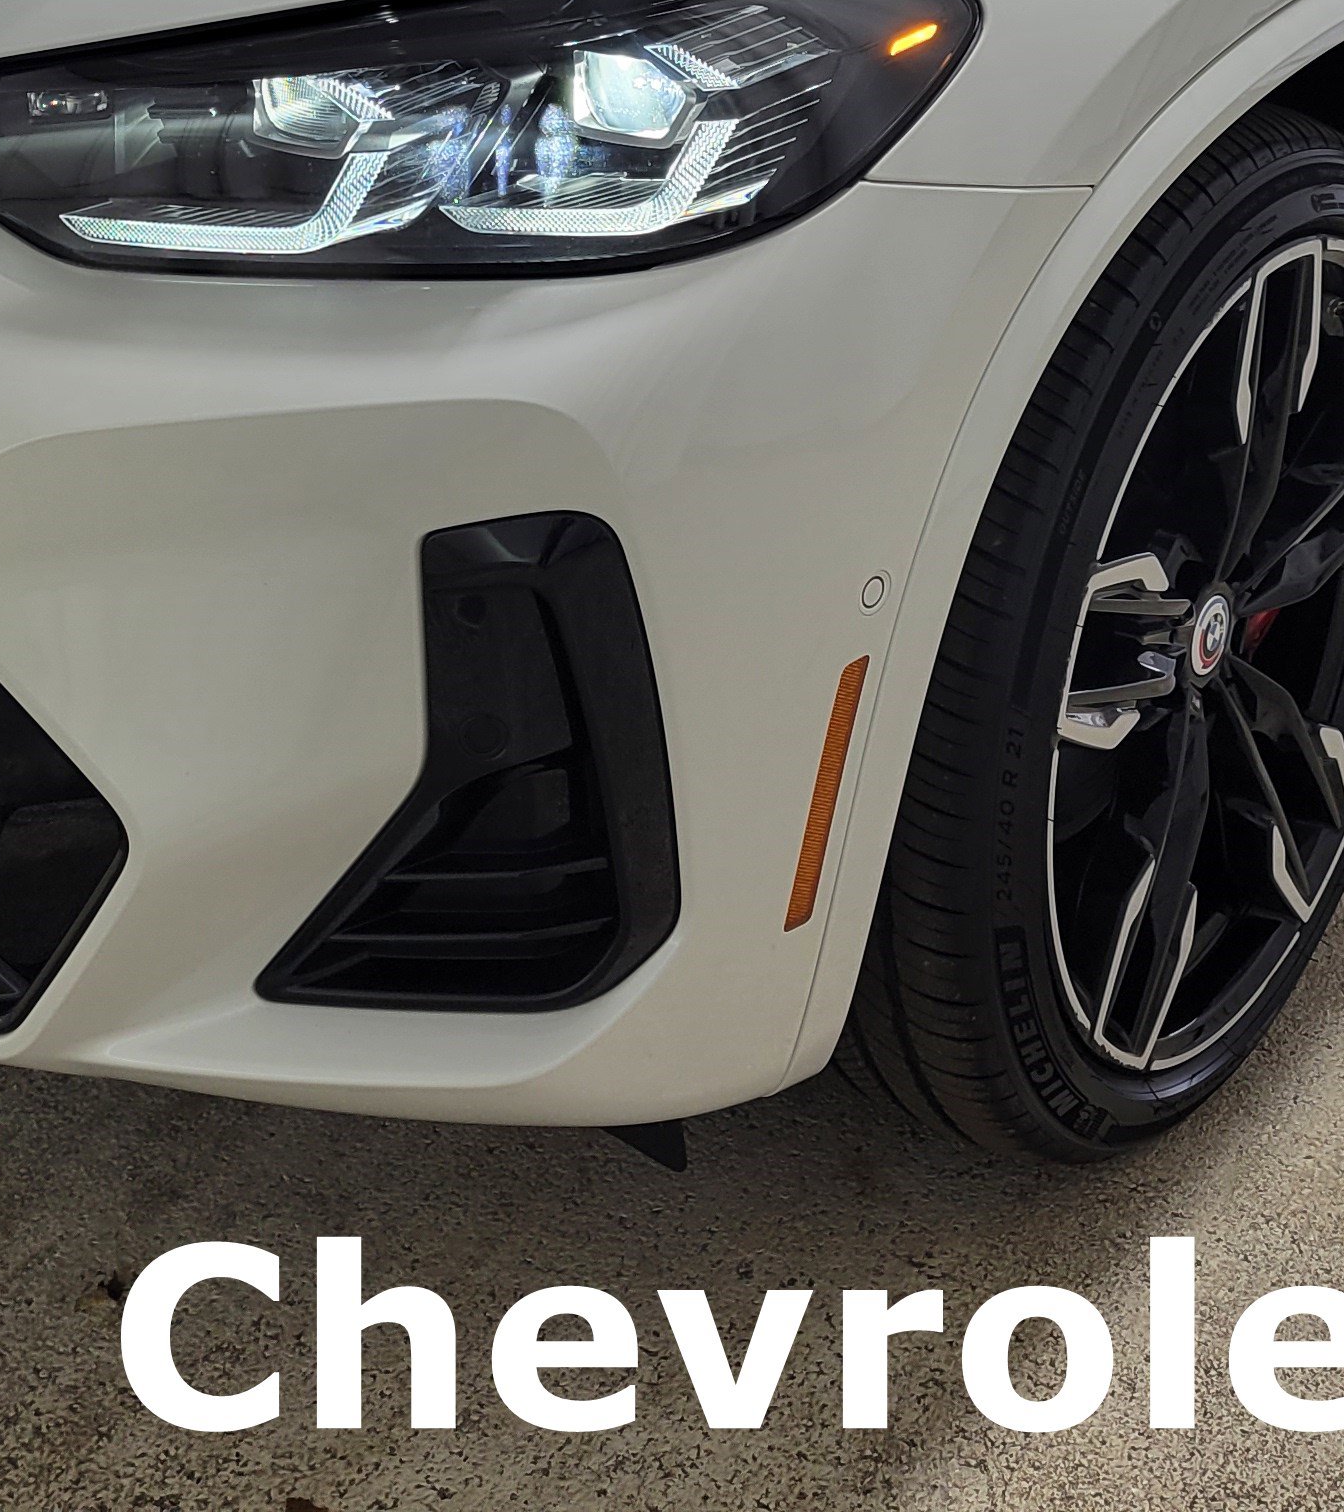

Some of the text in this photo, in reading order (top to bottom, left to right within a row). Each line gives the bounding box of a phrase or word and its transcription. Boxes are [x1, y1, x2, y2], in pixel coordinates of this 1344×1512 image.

[995, 725, 1026, 902] 245/40 R 21
[997, 941, 1082, 1122] MICHELIN
